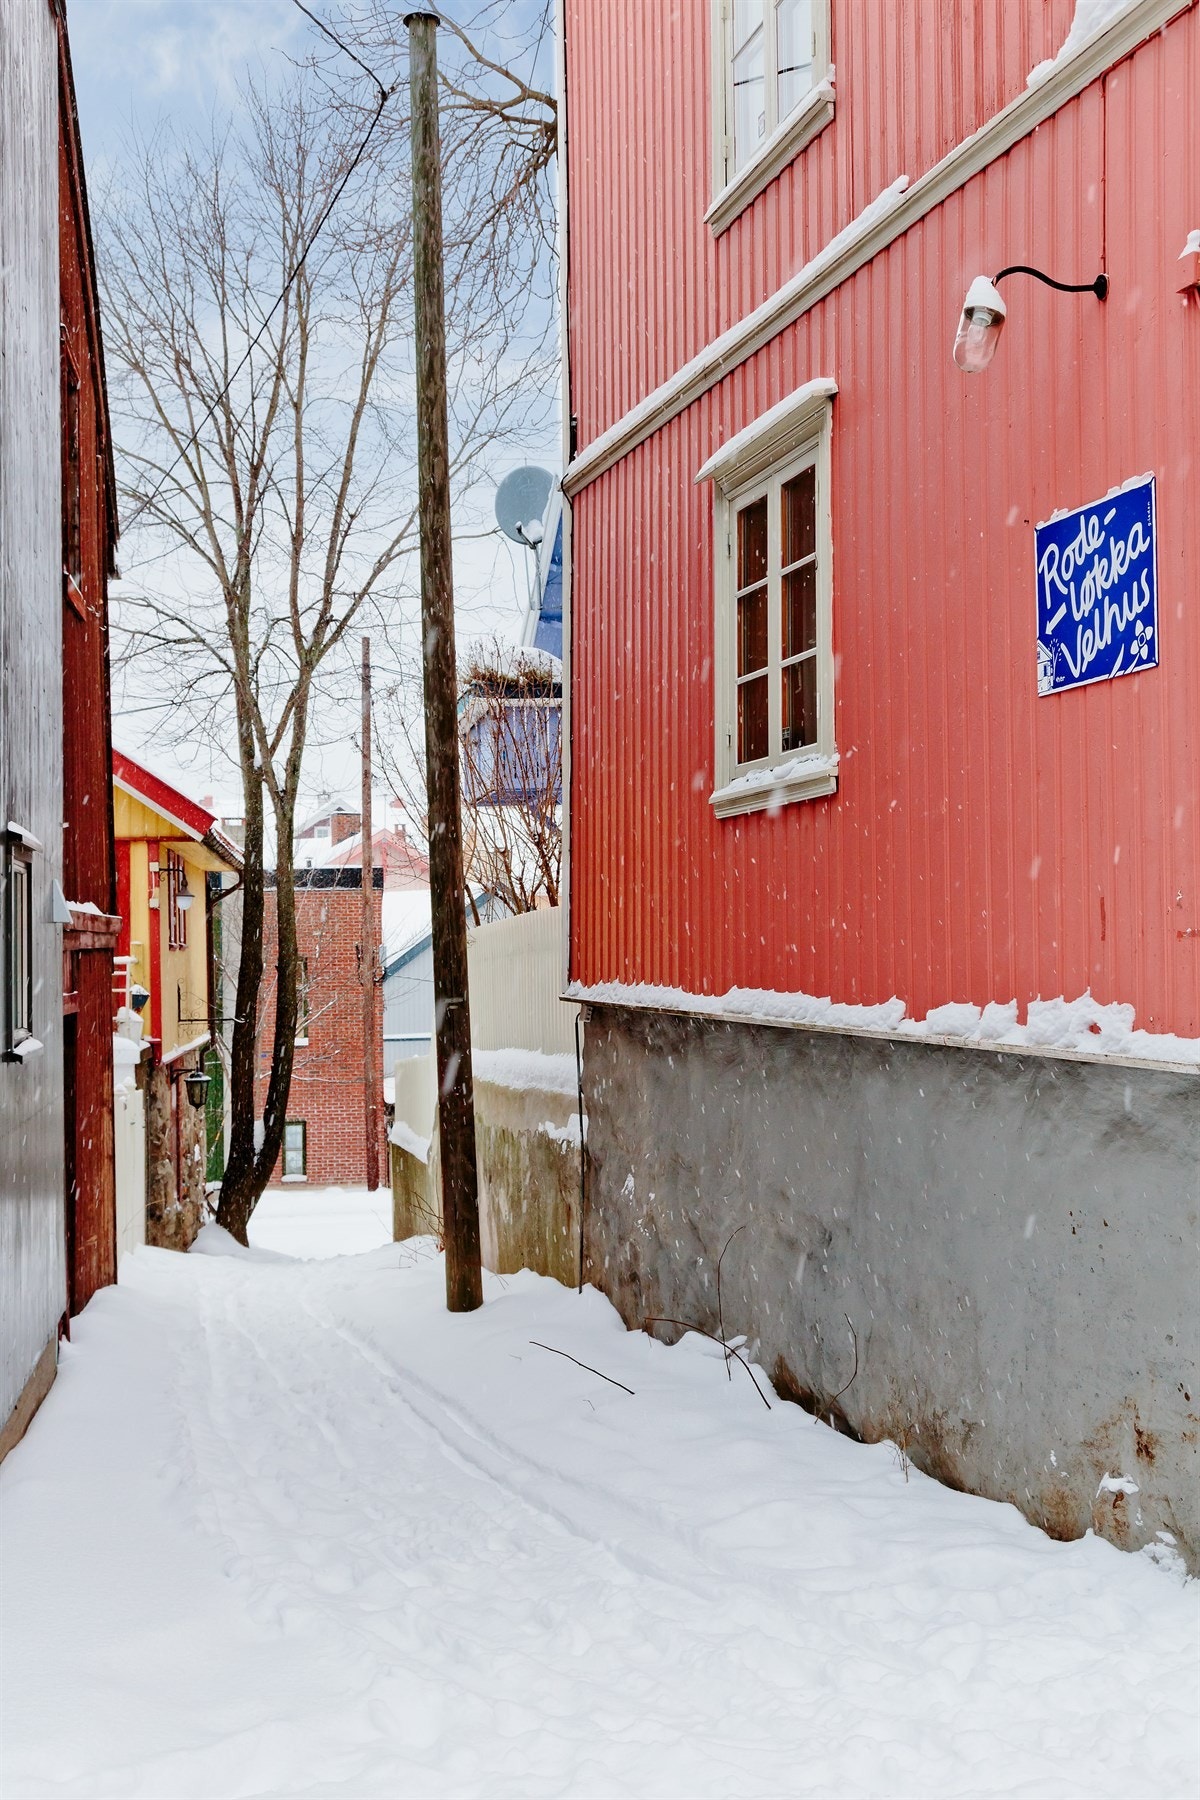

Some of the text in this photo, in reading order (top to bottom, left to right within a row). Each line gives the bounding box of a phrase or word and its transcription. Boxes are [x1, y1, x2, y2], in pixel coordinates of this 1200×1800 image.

[1039, 508, 1117, 609] Rode-
[1070, 522, 1151, 622] løkka
[1061, 568, 1151, 678] Velhus
